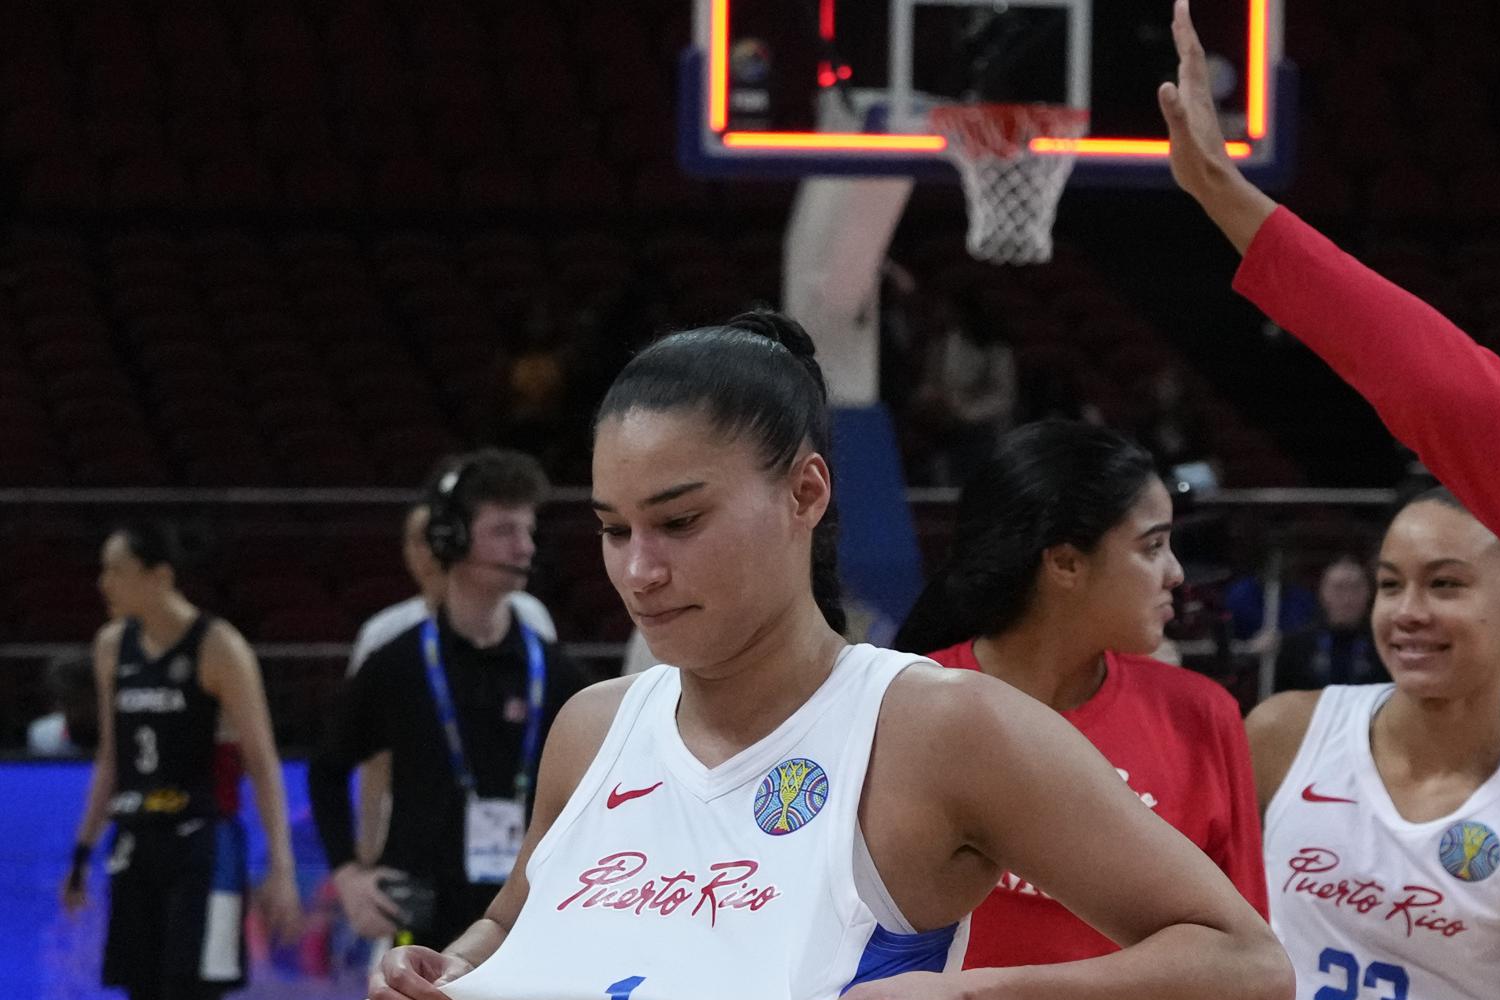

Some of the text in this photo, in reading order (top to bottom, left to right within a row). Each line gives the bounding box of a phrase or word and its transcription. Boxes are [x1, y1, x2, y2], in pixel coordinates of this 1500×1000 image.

[133, 724, 160, 774] 3
[556, 850, 781, 929] Puerto Rico
[1283, 847, 1468, 937] Puerto Rico
